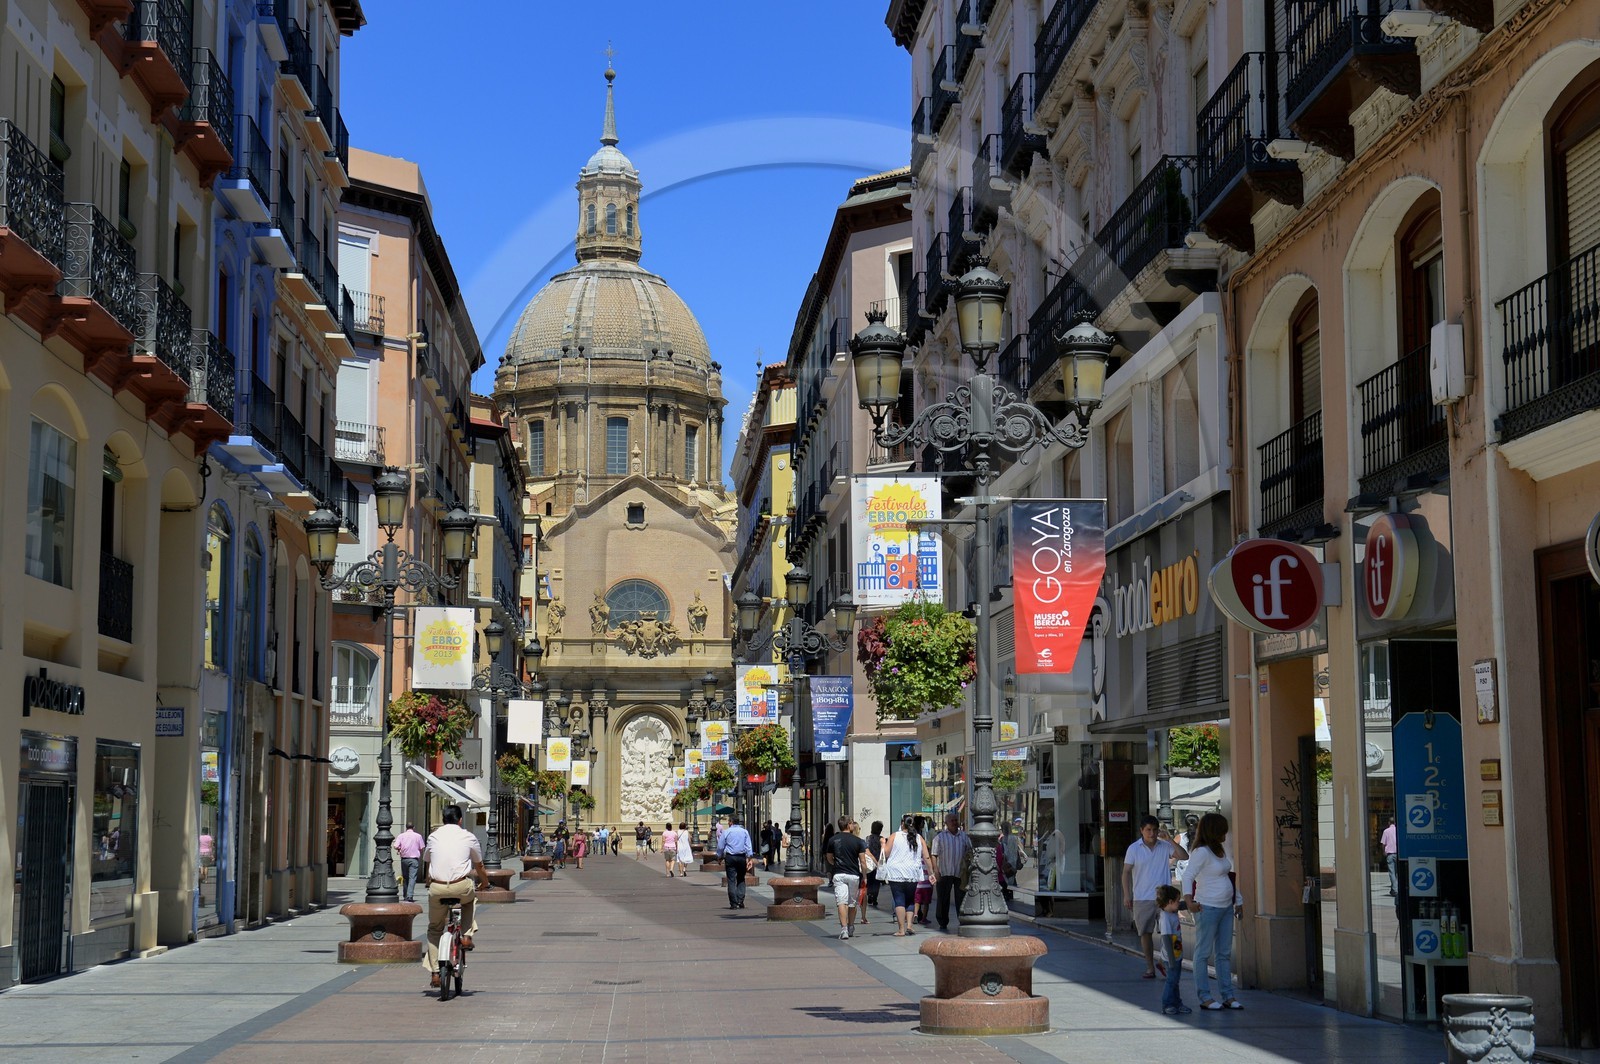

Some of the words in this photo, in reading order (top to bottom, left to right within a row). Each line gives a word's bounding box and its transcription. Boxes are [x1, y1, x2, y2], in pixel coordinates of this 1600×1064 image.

[865, 496, 927, 511] Festivales
[868, 511, 908, 522] EBRO
[911, 510, 935, 519] 2013
[1061, 507, 1074, 558] Zaragoza
[1030, 507, 1062, 604] GOYA
[1064, 560, 1072, 573] en
[1371, 534, 1386, 606] if
[1252, 554, 1298, 620] if
[1034, 619, 1070, 627] IBERCAJA
[431, 635, 462, 645] EBRO
[433, 650, 453, 658] 2013
[22, 667, 85, 717] pekenova
[815, 685, 849, 693] ARAGÓN
[444, 760, 478, 770] Outlet
